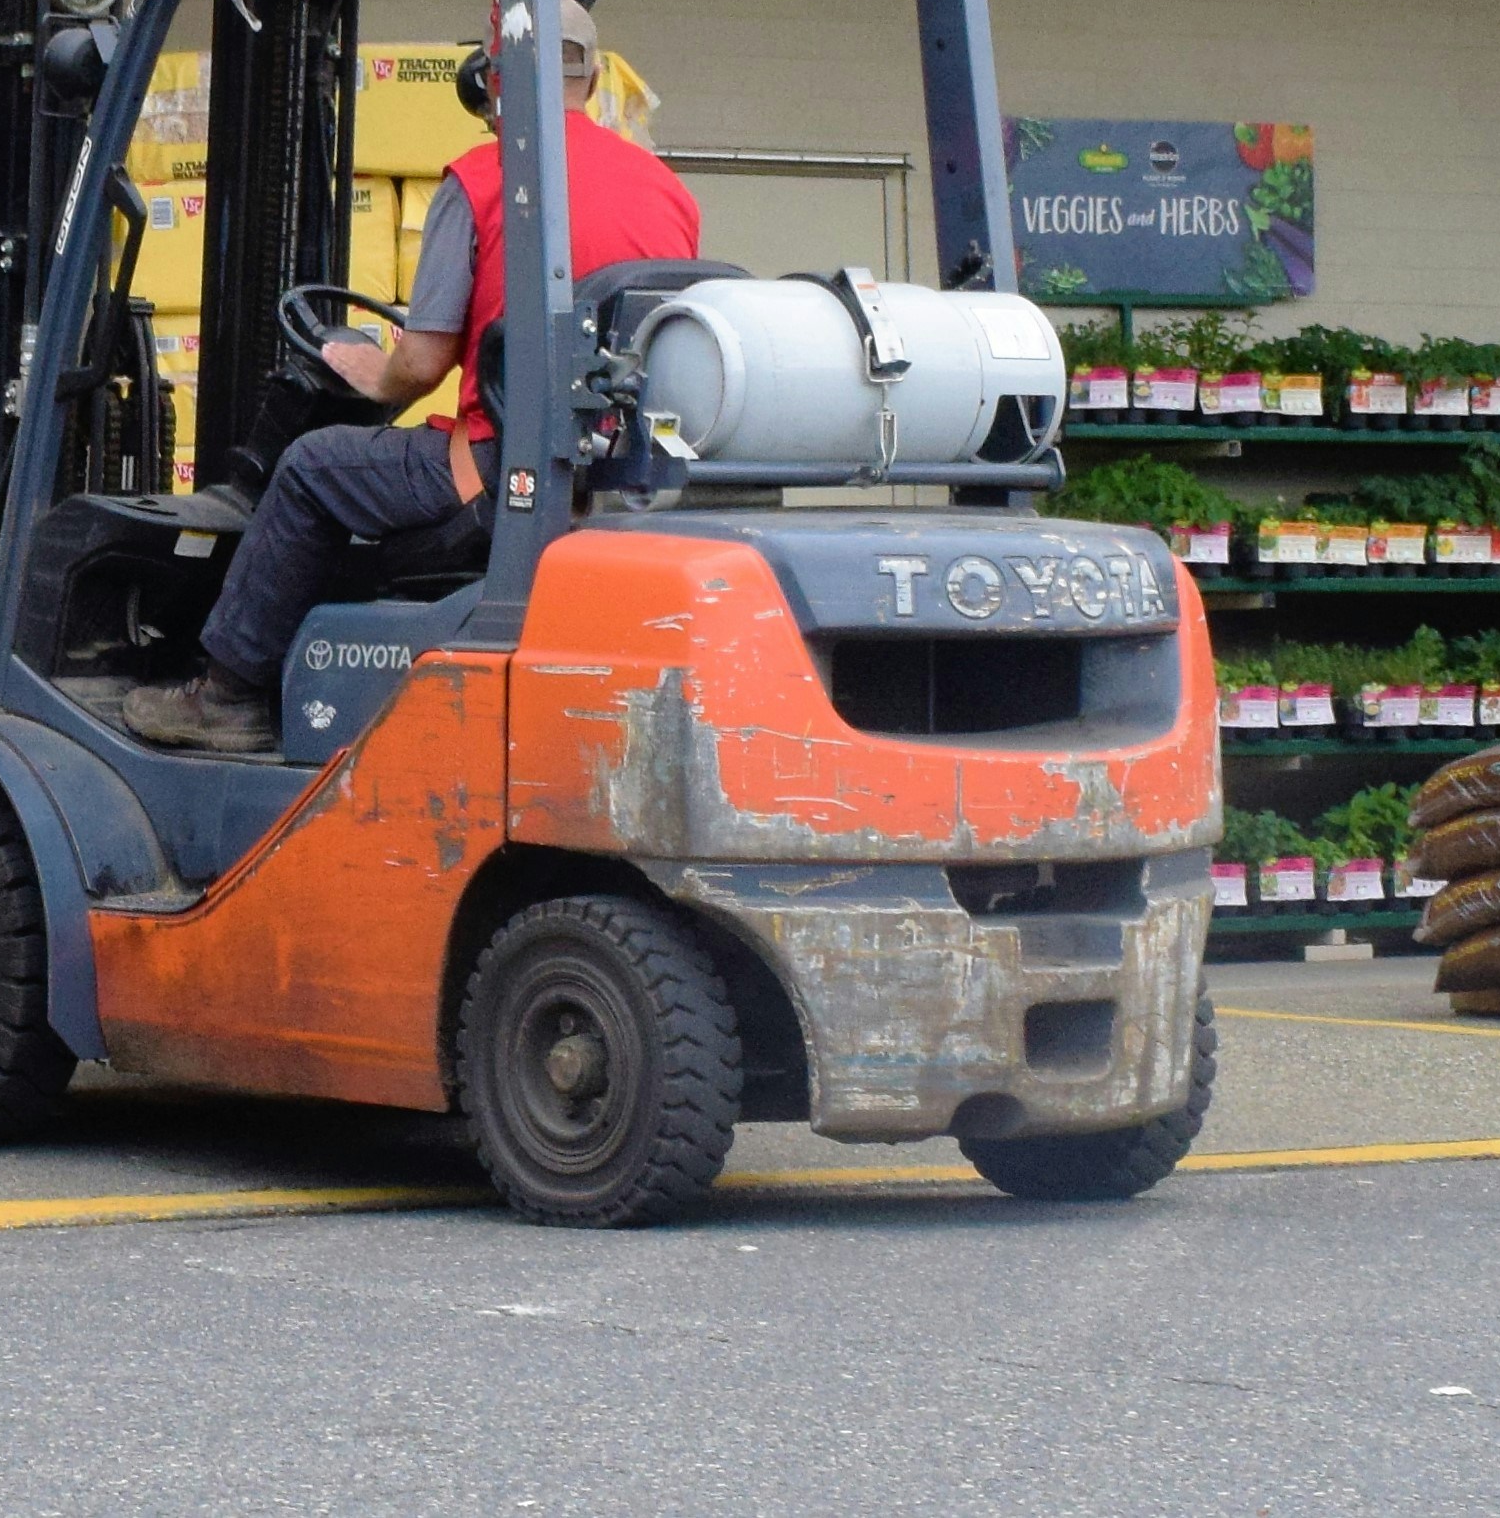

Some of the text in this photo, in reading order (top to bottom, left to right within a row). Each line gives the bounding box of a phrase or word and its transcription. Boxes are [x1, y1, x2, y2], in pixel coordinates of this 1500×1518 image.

[373, 59, 394, 78] TSC
[397, 58, 456, 70] TRACTOR
[396, 71, 440, 83] SUPPLY
[1023, 195, 1240, 237] VEGGIES and HERBS
[509, 471, 535, 496] SAS
[875, 554, 1166, 620] TOYOTA
[336, 643, 412, 669] TOYOTA
